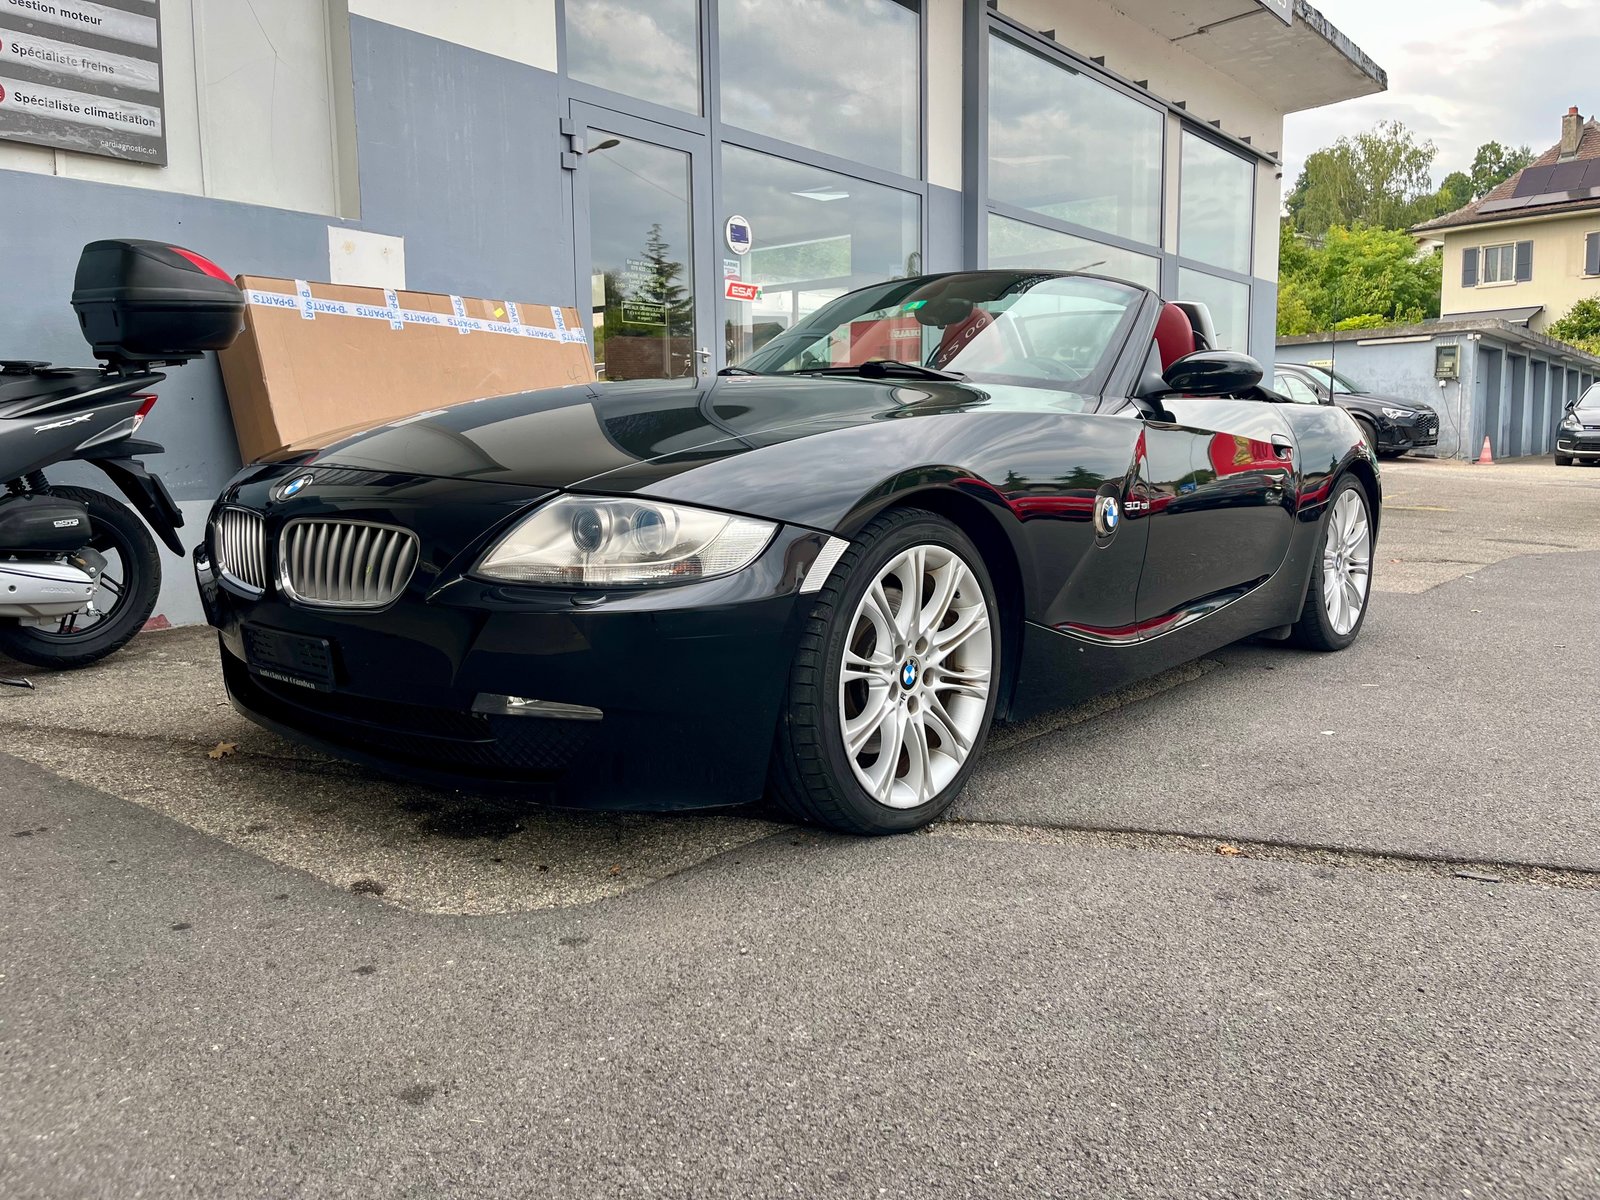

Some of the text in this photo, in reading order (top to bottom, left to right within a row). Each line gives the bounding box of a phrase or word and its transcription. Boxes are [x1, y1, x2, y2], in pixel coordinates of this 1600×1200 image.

[60, 8, 102, 26] moteur
[11, 43, 115, 74] Spécialiste freins
[14, 92, 156, 127] Spécialiste climatisation
[100, 139, 157, 155] cardiagnostic.ch
[731, 285, 753, 297] ESA
[34, 412, 94, 435] PCX
